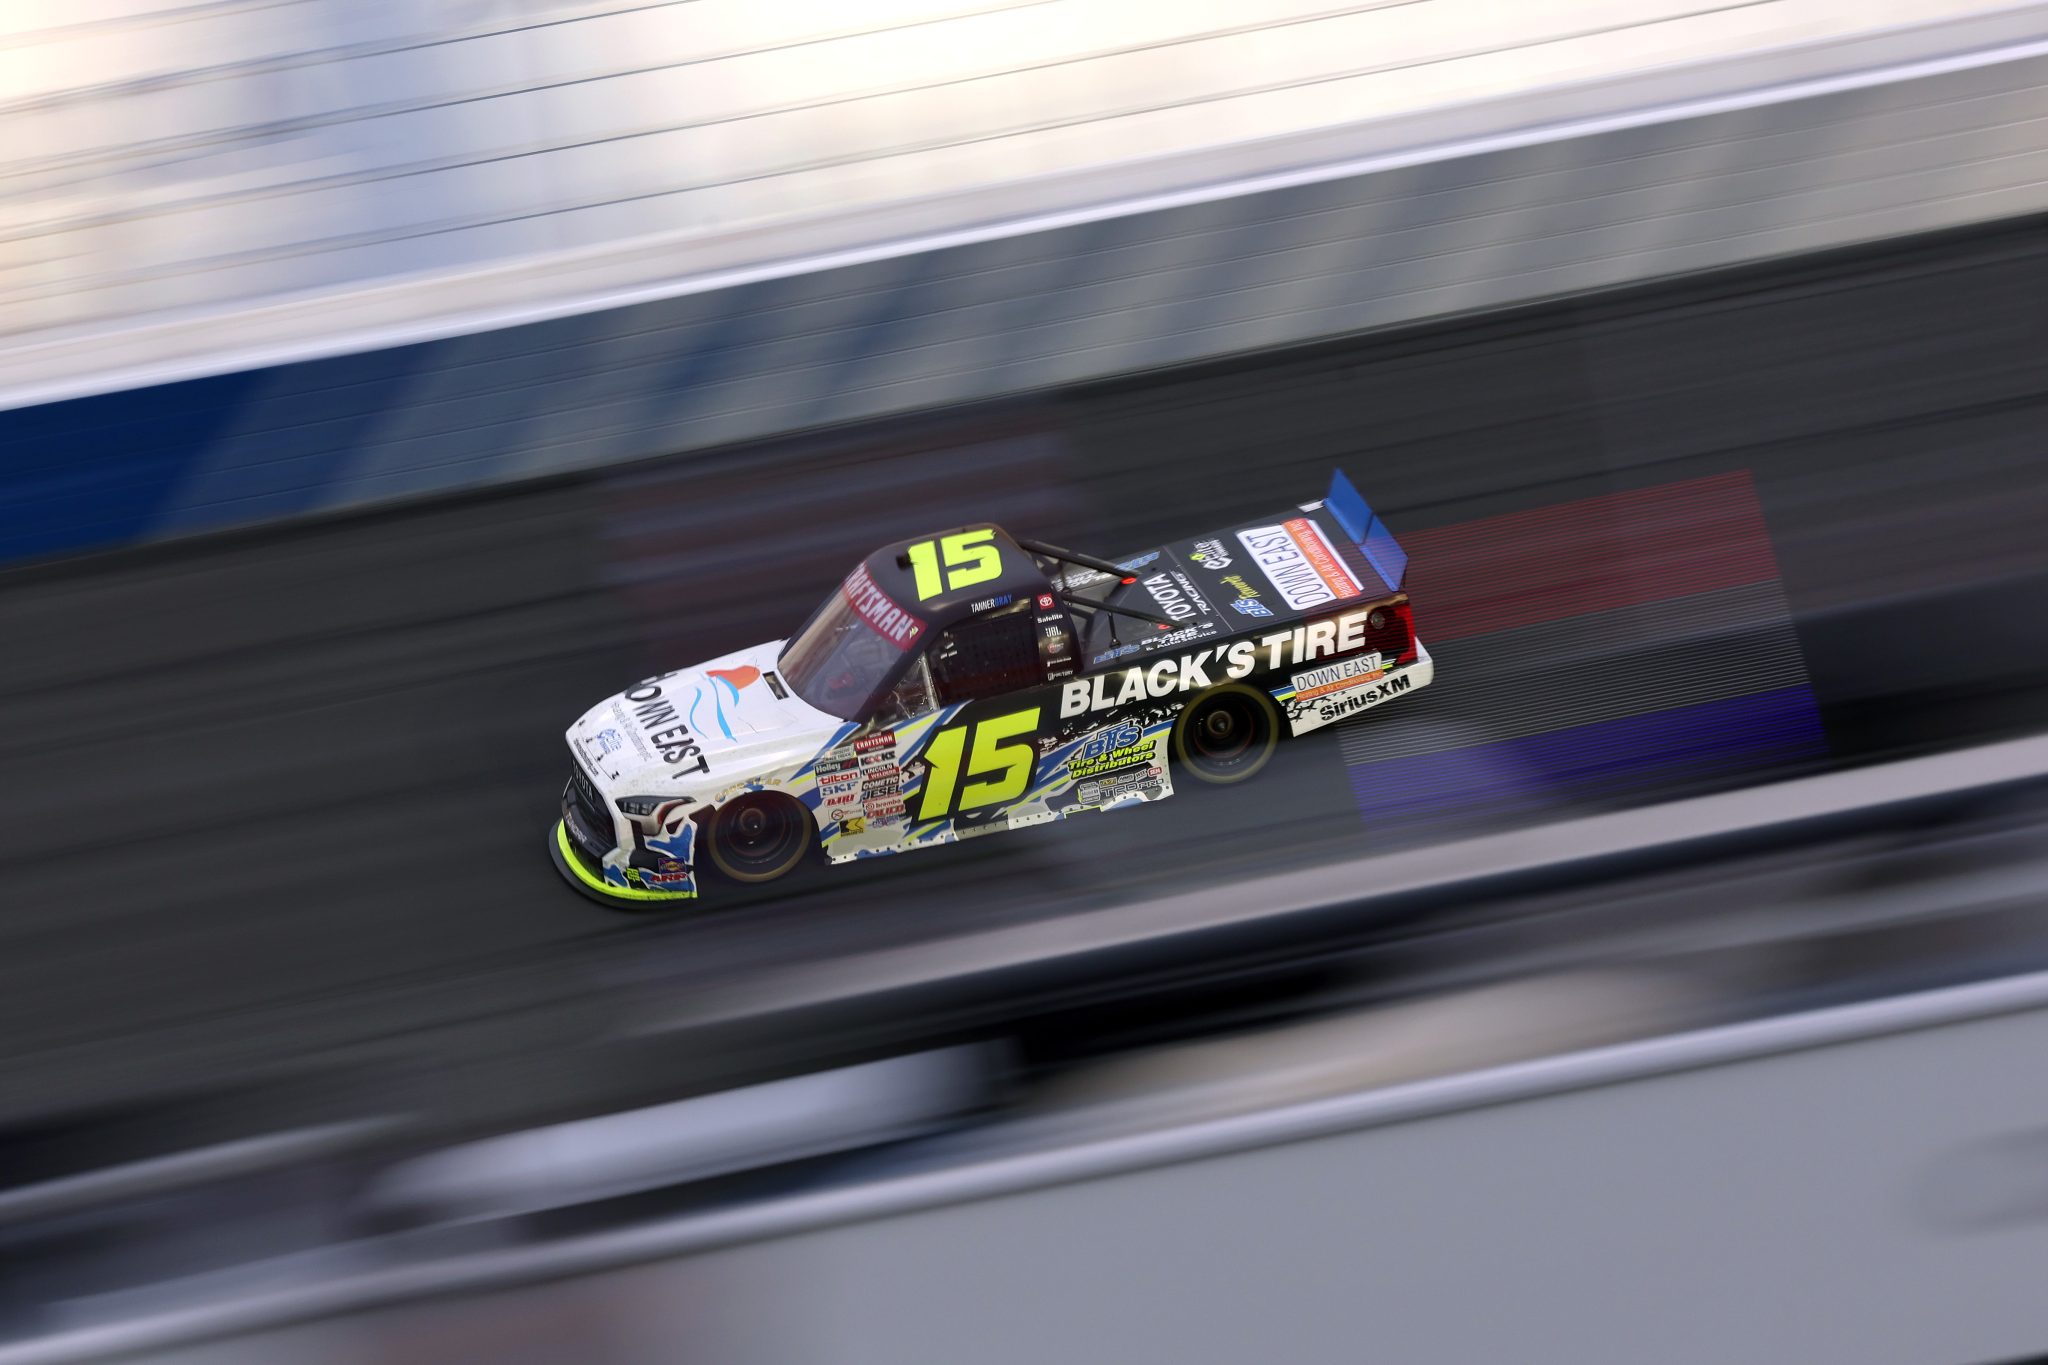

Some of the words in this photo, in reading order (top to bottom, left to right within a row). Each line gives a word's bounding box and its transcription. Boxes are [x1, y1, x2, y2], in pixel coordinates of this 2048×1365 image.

[1246, 530, 1298, 565] EAST
[908, 528, 1003, 601] 15
[1170, 570, 1211, 615] RACING
[1274, 562, 1330, 605] DOWN
[1143, 573, 1196, 621] TOYOTA
[1037, 613, 1063, 624] Safelite
[1045, 625, 1062, 637] JBL
[1141, 622, 1214, 645] BLACK'S
[1060, 641, 1256, 719] BLACK'S
[1264, 611, 1368, 670] TIRE
[1296, 668, 1340, 691] DOWN
[1344, 656, 1377, 677] EAST
[1320, 674, 1411, 721] SiriusXM
[651, 724, 710, 779] EAST
[856, 735, 893, 749] CRAFTSMAN
[1083, 723, 1140, 760] BTS
[917, 707, 1041, 821] 15
[1069, 757, 1095, 770] Tire
[1099, 752, 1108, 762] &
[1113, 741, 1154, 758] Wheel
[1072, 752, 1154, 778] Distributors
[816, 763, 840, 775] Holley
[820, 772, 858, 785] tilton
[862, 763, 893, 776] LINCOLN
[822, 781, 858, 796] SKF
[861, 785, 900, 800] JESEL
[863, 776, 898, 789] COMETIC
[1100, 783, 1138, 798] TRD
[1139, 778, 1163, 789] PRO
[876, 799, 900, 808] brembo
[651, 873, 687, 882] ARP
